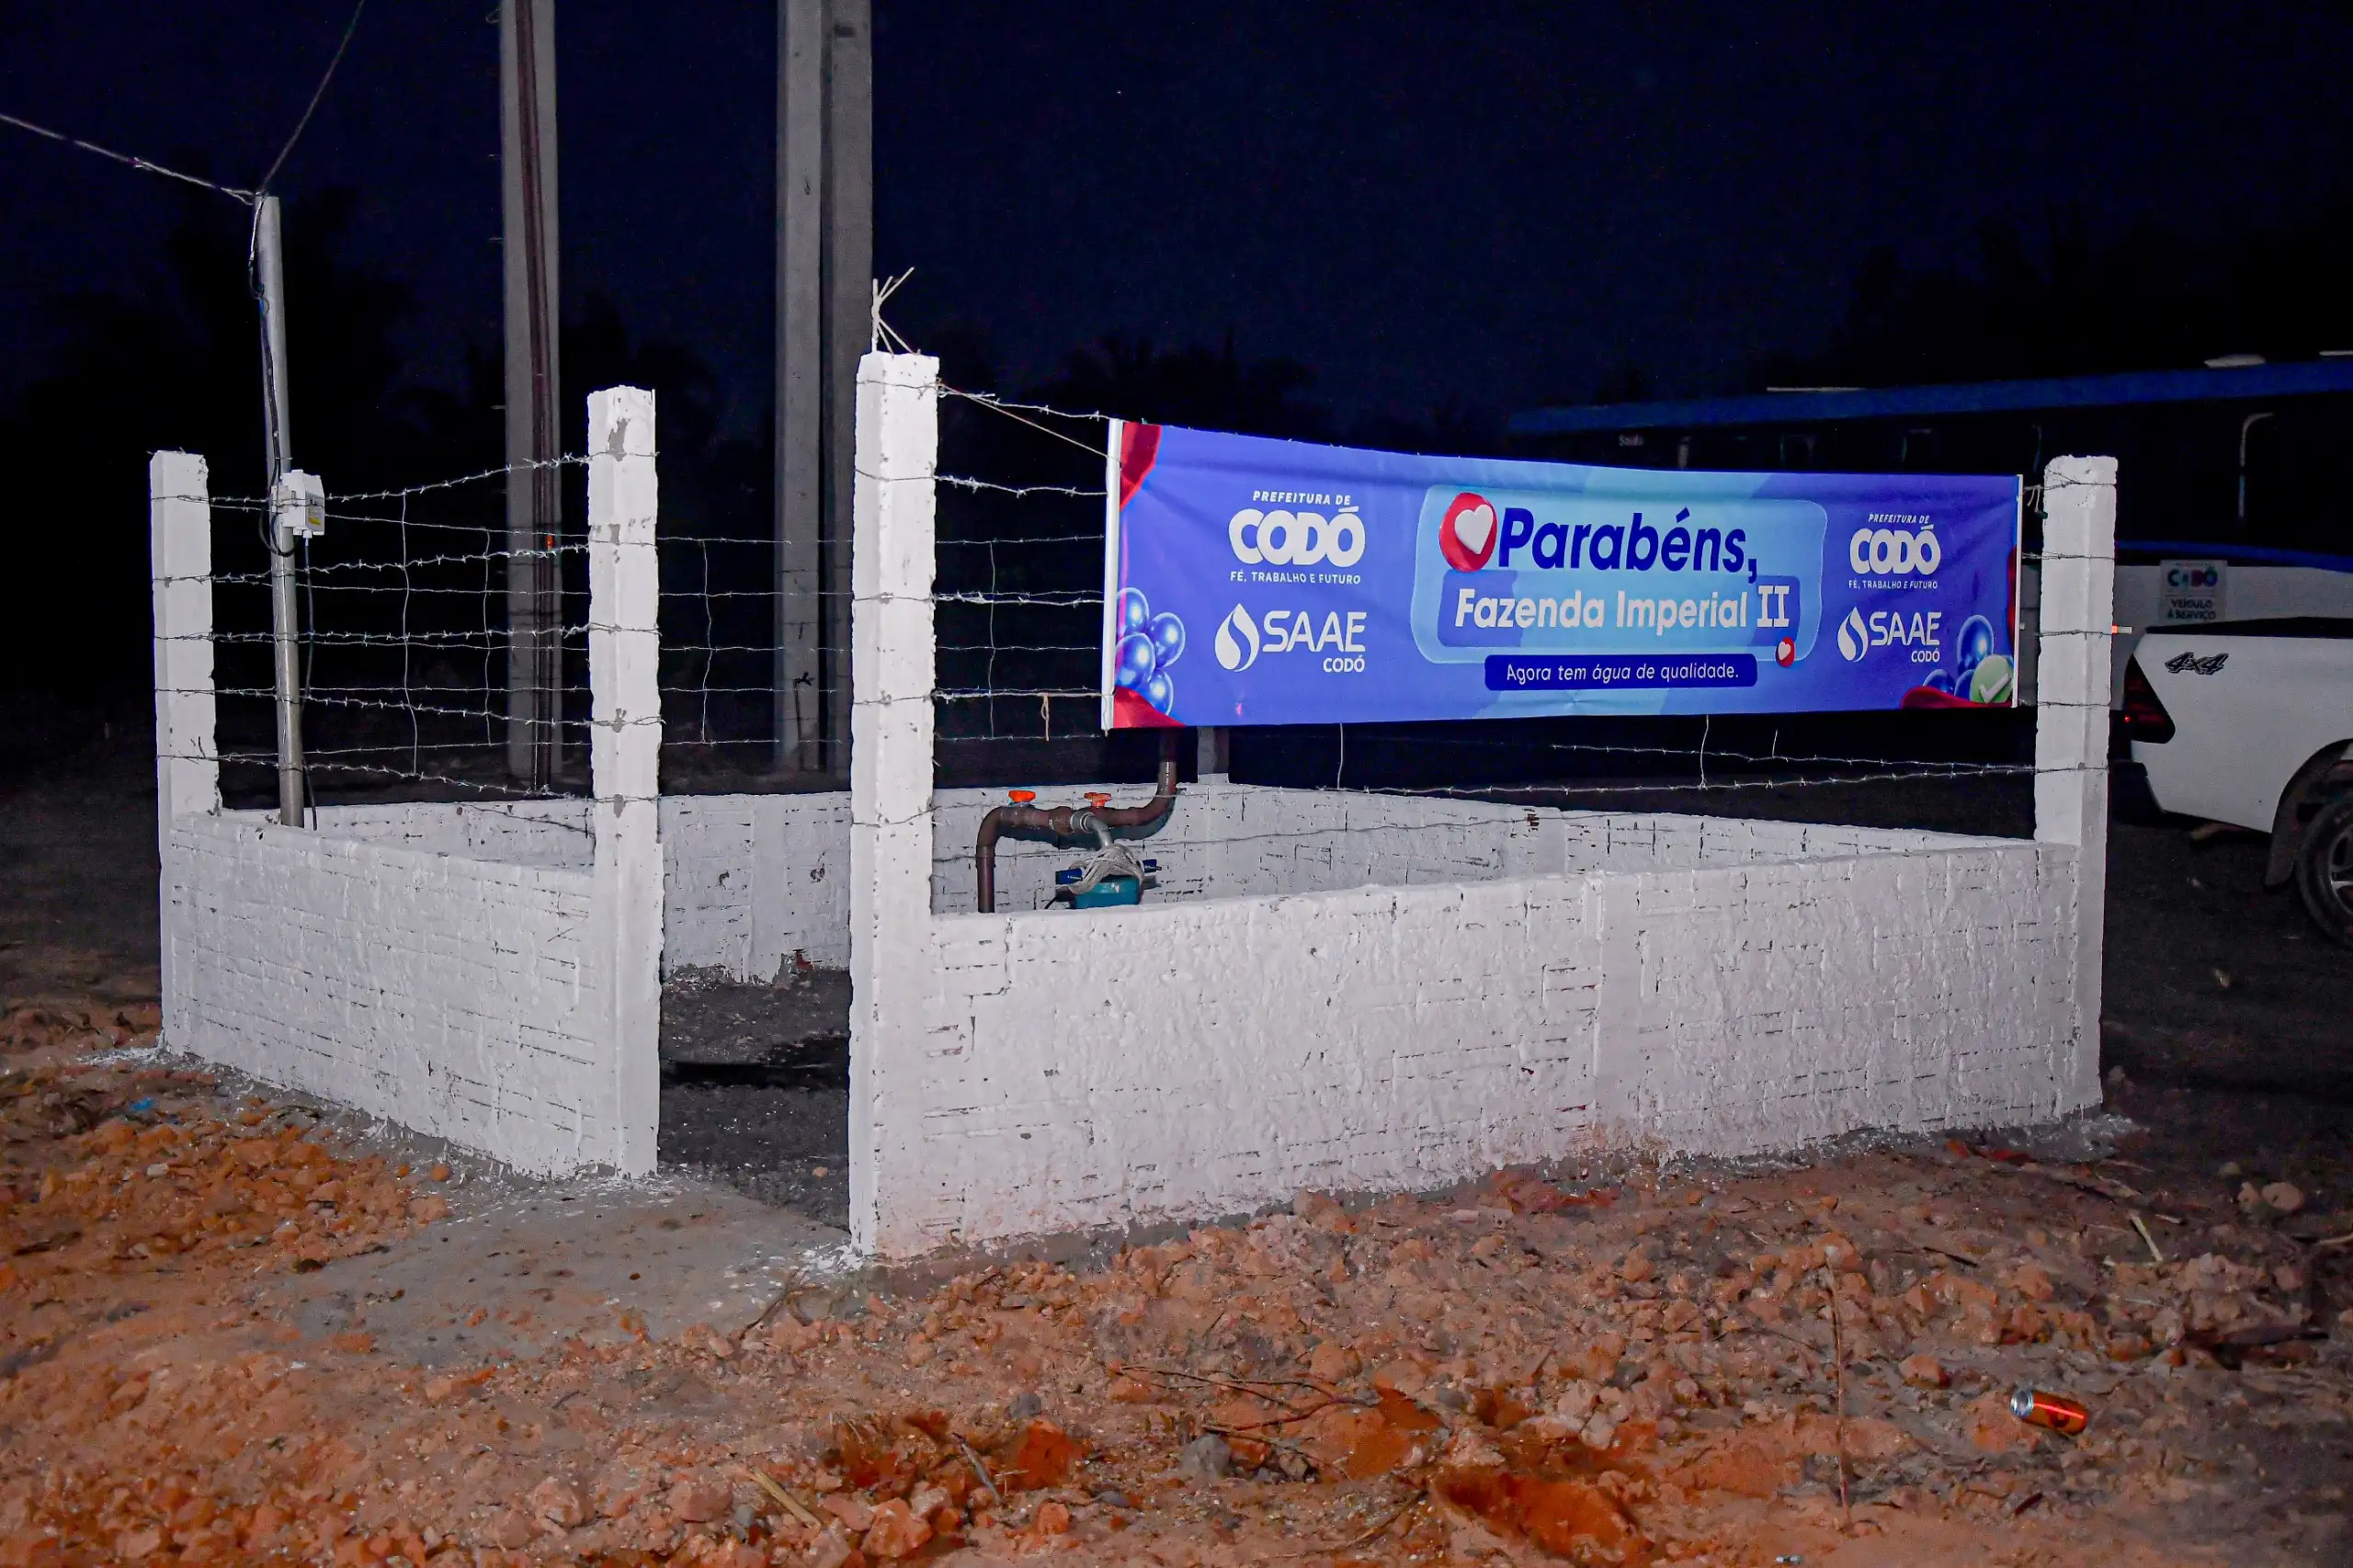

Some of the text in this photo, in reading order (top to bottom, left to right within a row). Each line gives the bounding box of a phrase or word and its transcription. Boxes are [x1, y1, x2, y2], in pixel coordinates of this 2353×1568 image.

[1253, 490, 1351, 506] PREFEITURA DE
[1868, 513, 1929, 524] PREFEITURA DE
[1228, 506, 1366, 568] CODÓ
[1498, 506, 1757, 584] Parabéns,
[1849, 524, 1941, 575] CODÓ
[1230, 569, 1361, 585] FÉ, TRABALHO E FUTURO
[1848, 579, 1938, 590] FÉ, TRABALHO E FUTURO
[1454, 584, 1790, 636] Fazenda Imperial II
[1262, 610, 1367, 653] SAAE
[1869, 611, 1942, 646] SAAE
[1323, 654, 1366, 673] CODÓ
[1911, 648, 1940, 663] CODÓ
[2164, 651, 2230, 676] 4x4
[1506, 662, 1739, 685] Agora tem água de qualidade.
